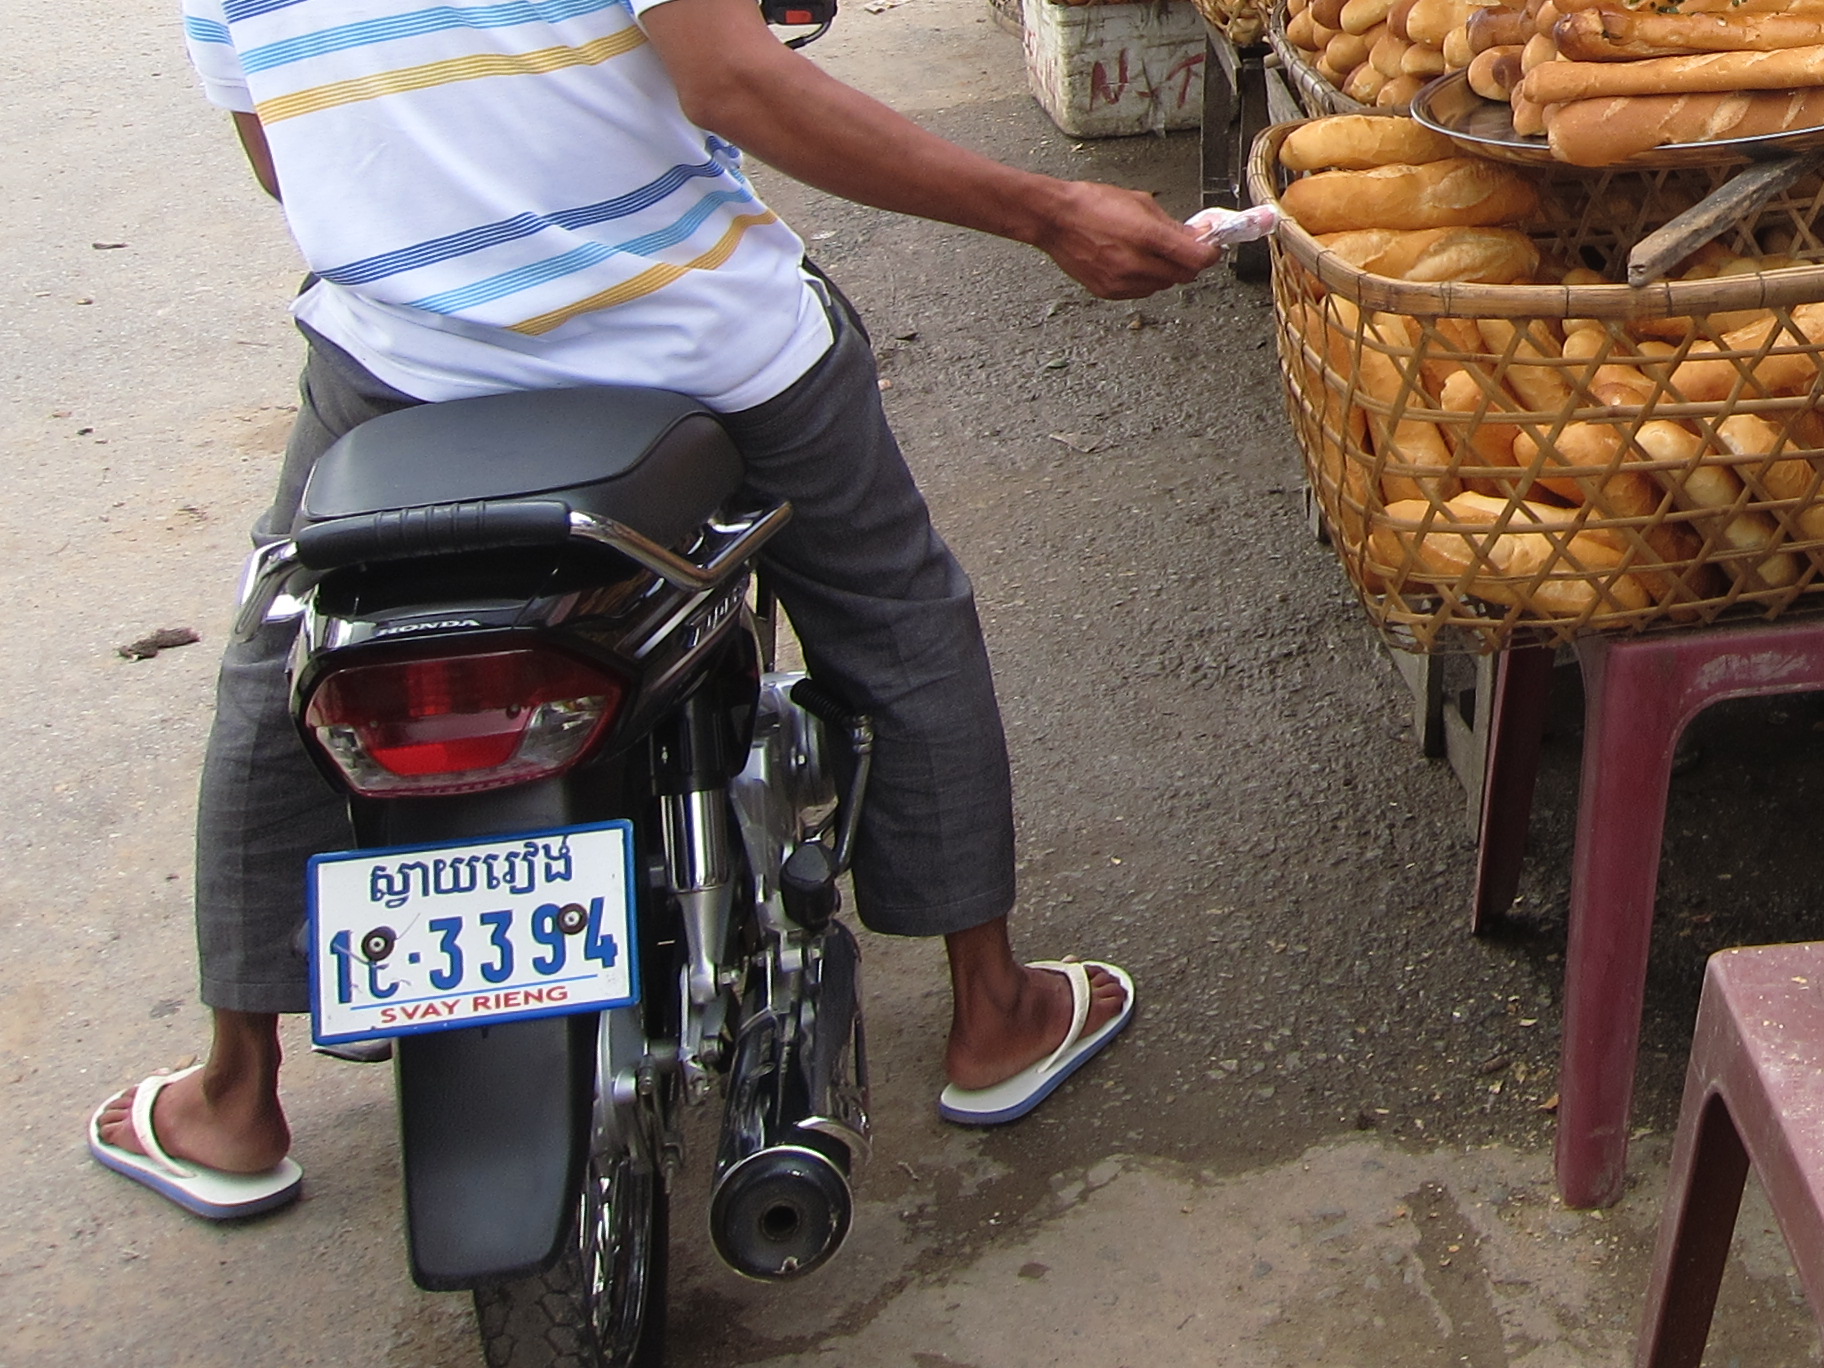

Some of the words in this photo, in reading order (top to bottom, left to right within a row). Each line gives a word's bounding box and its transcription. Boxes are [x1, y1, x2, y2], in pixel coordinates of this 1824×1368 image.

[376, 619, 481, 637] HONDA
[381, 998, 461, 1025] SVAY
[472, 985, 569, 1013] RIENG
